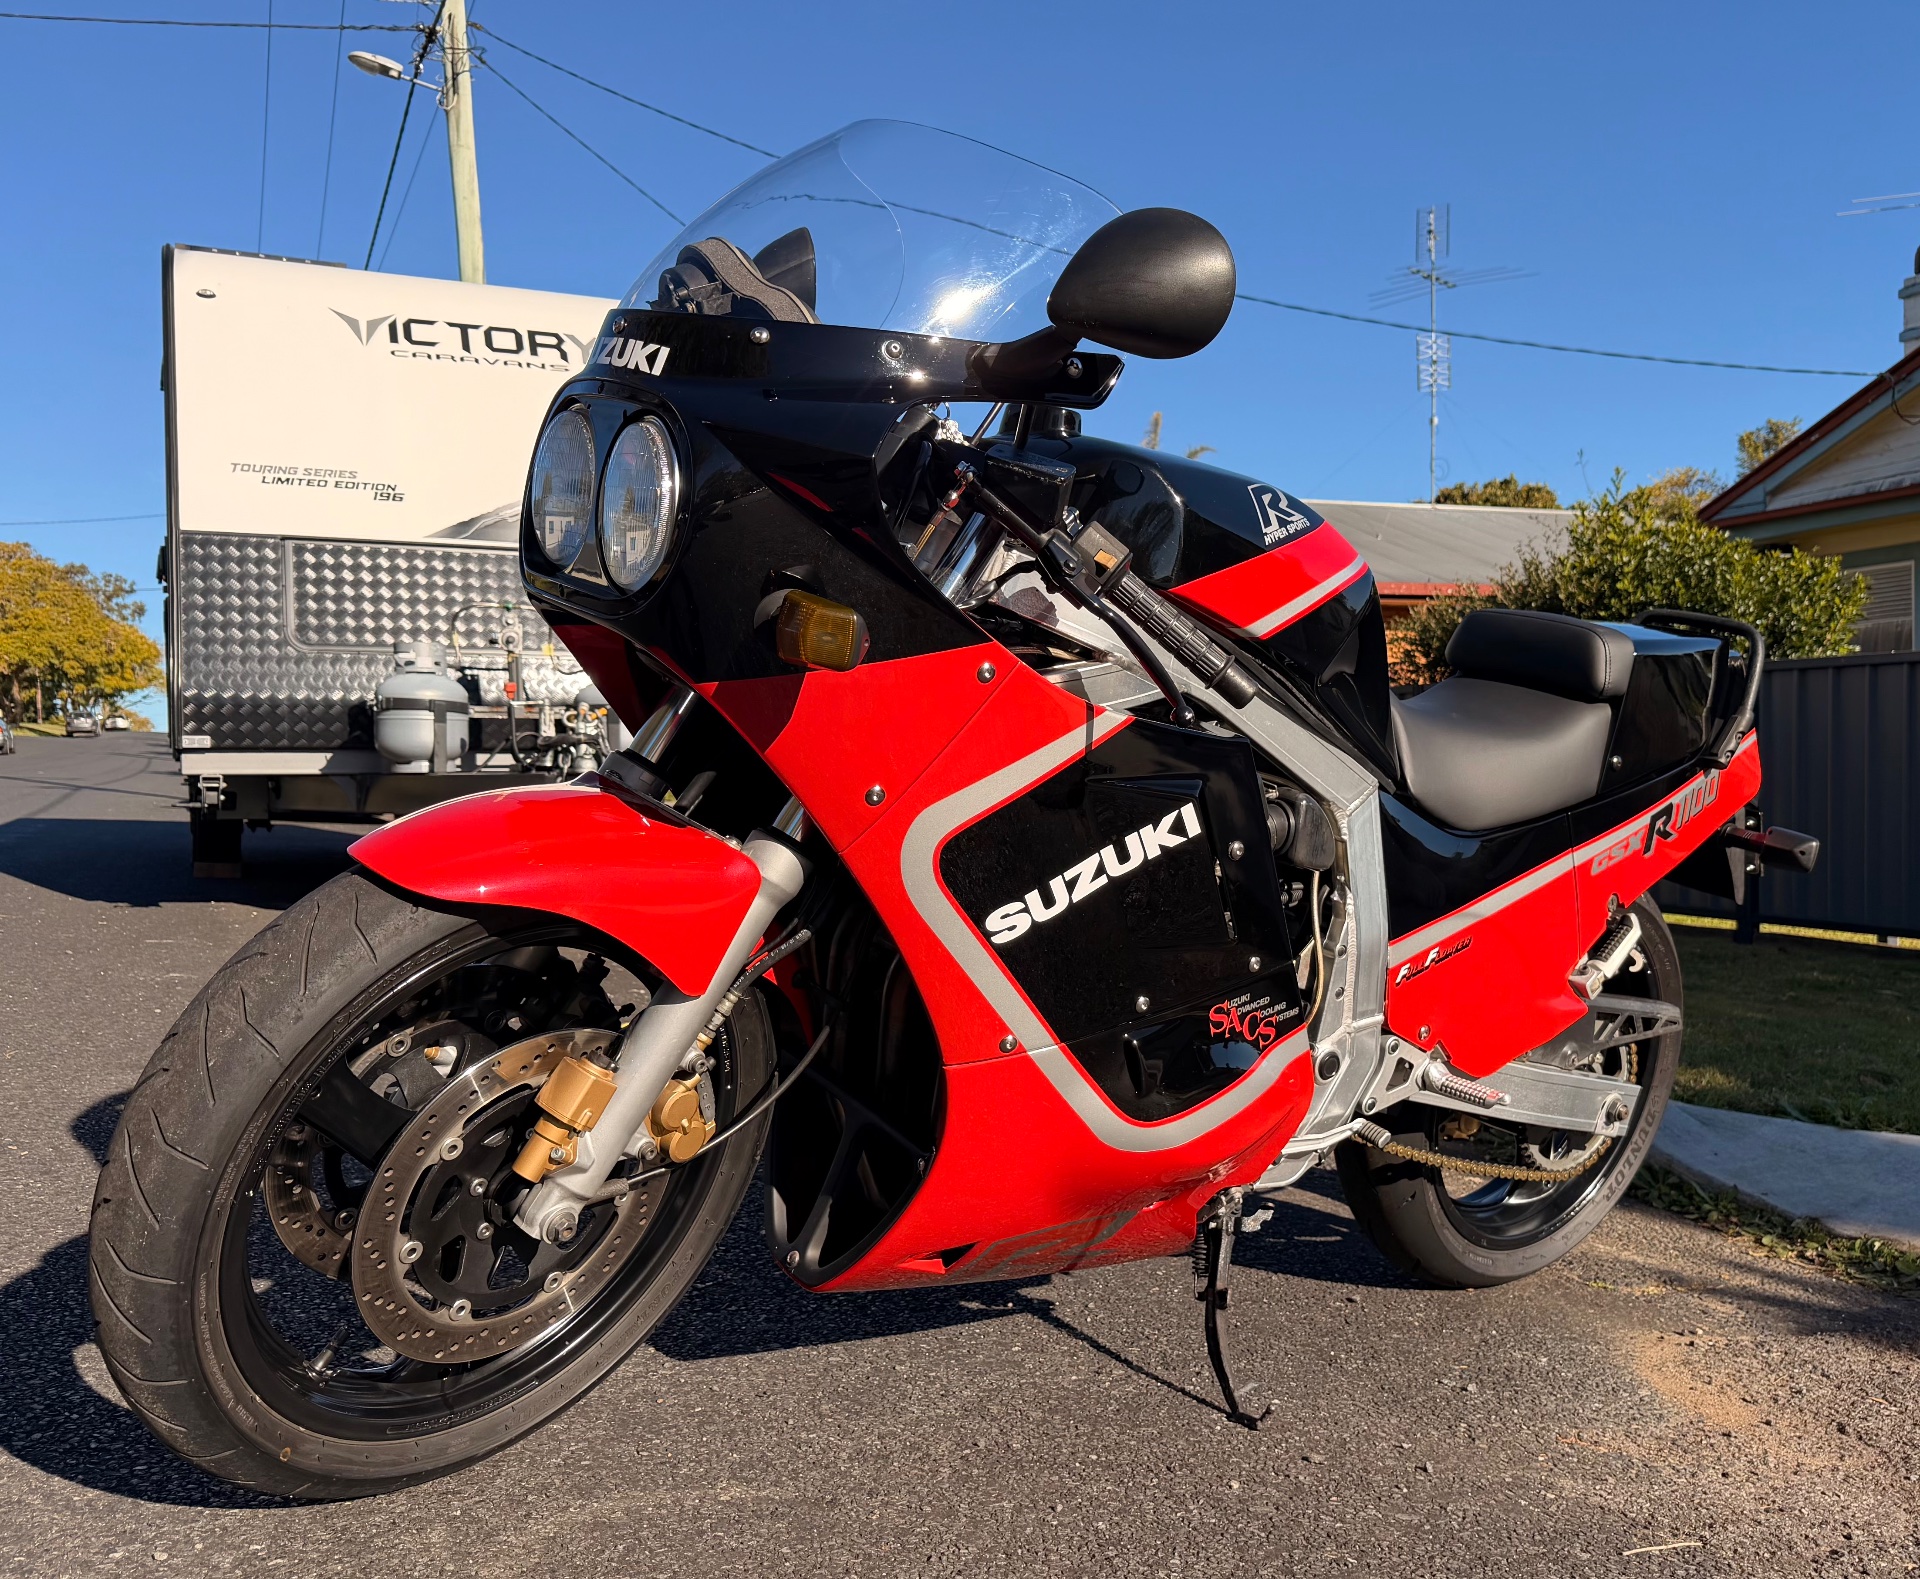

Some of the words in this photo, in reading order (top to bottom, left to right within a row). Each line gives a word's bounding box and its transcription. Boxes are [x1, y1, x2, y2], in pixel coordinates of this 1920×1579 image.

[328, 307, 596, 365] VICTORY
[390, 350, 570, 372] CARAVANS
[588, 337, 670, 376] ZUKI
[231, 463, 298, 475] TOURING
[302, 467, 358, 479] SERIES
[261, 476, 328, 488] LIMITED
[334, 480, 397, 492] EDITION
[373, 491, 405, 502] 196
[1247, 483, 1304, 534] R
[1264, 528, 1288, 546] HYPER
[1286, 517, 1311, 534] SPORTS
[985, 802, 1202, 944] SUZUKI
[1602, 1106, 1656, 1203] DUNLOP
